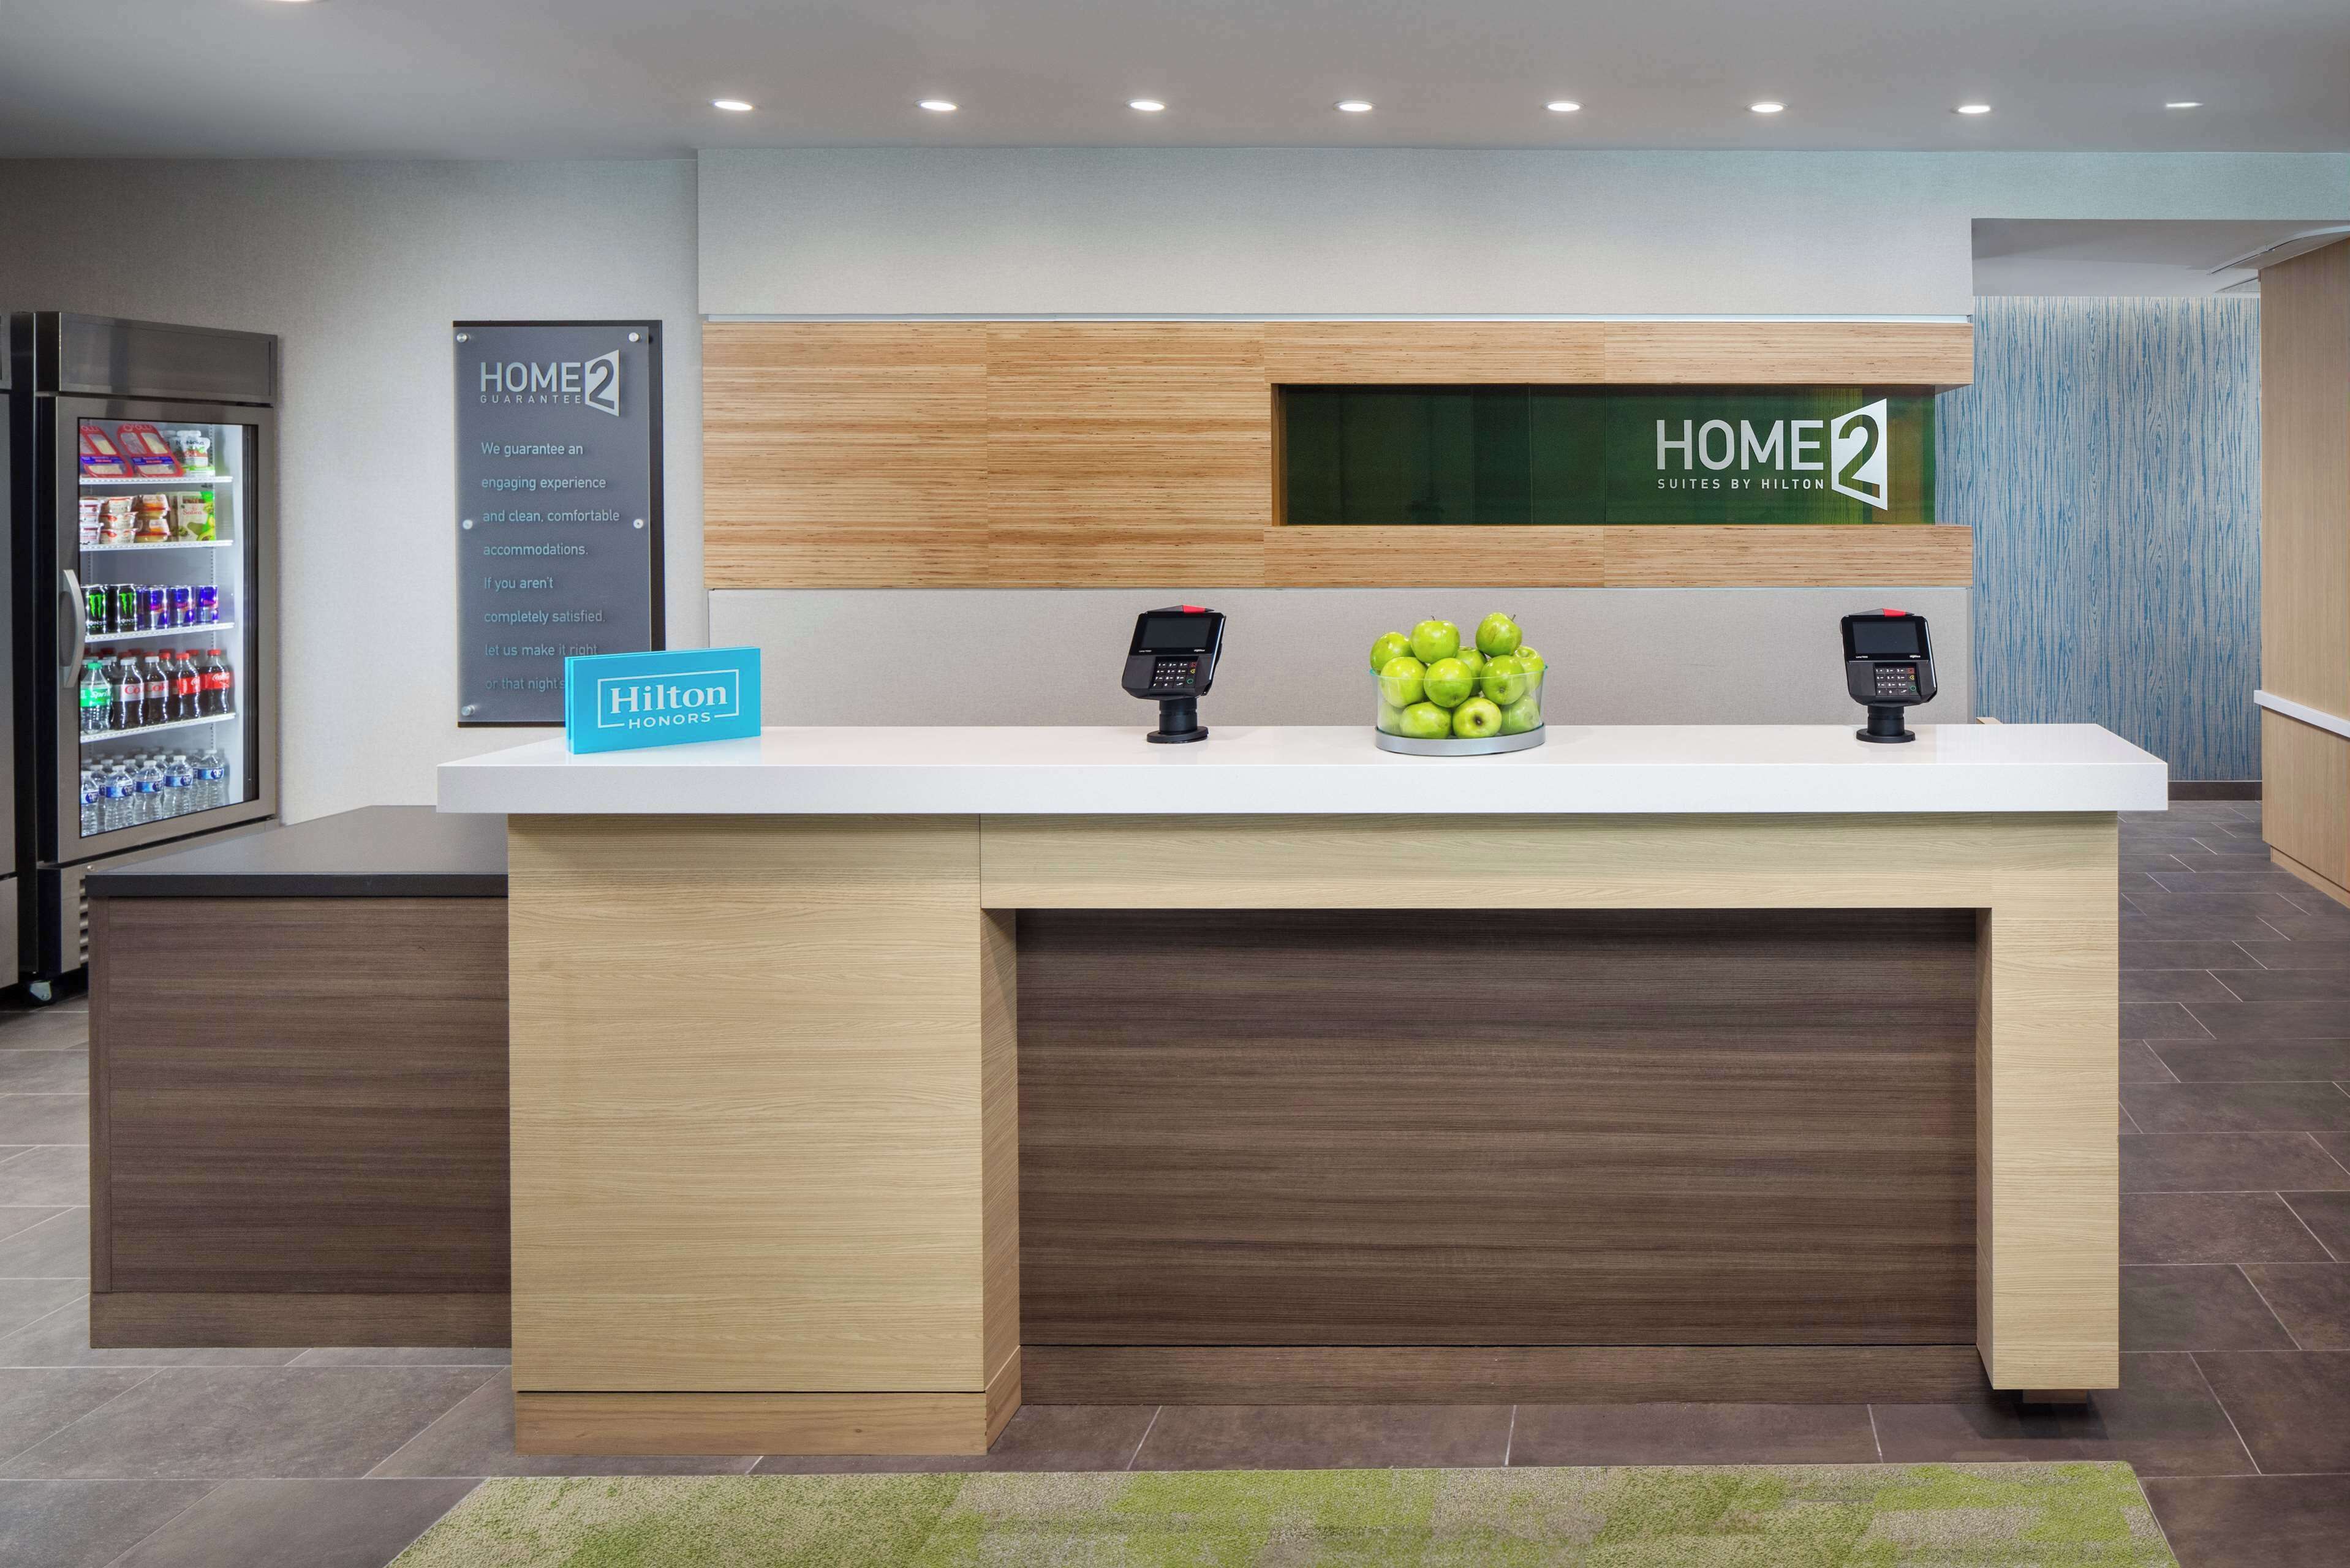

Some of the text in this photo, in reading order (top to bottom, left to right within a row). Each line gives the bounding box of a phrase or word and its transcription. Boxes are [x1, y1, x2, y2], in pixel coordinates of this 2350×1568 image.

[480, 394, 581, 404] GUARANTEE
[481, 442, 583, 457] We guarantee an
[482, 475, 606, 491] engaging experience
[1658, 478, 1824, 489] SUITES BY HILTON
[483, 510, 505, 522] and
[547, 509, 620, 522] comfortable
[483, 543, 589, 555] accommodations.
[484, 577, 491, 589] If
[495, 579, 516, 592] you
[484, 610, 549, 625] completely
[485, 644, 598, 656] let us make it right
[485, 679, 498, 689] or
[502, 677, 524, 689] that
[610, 684, 728, 714] Hilton
[629, 712, 711, 729] HONORS
